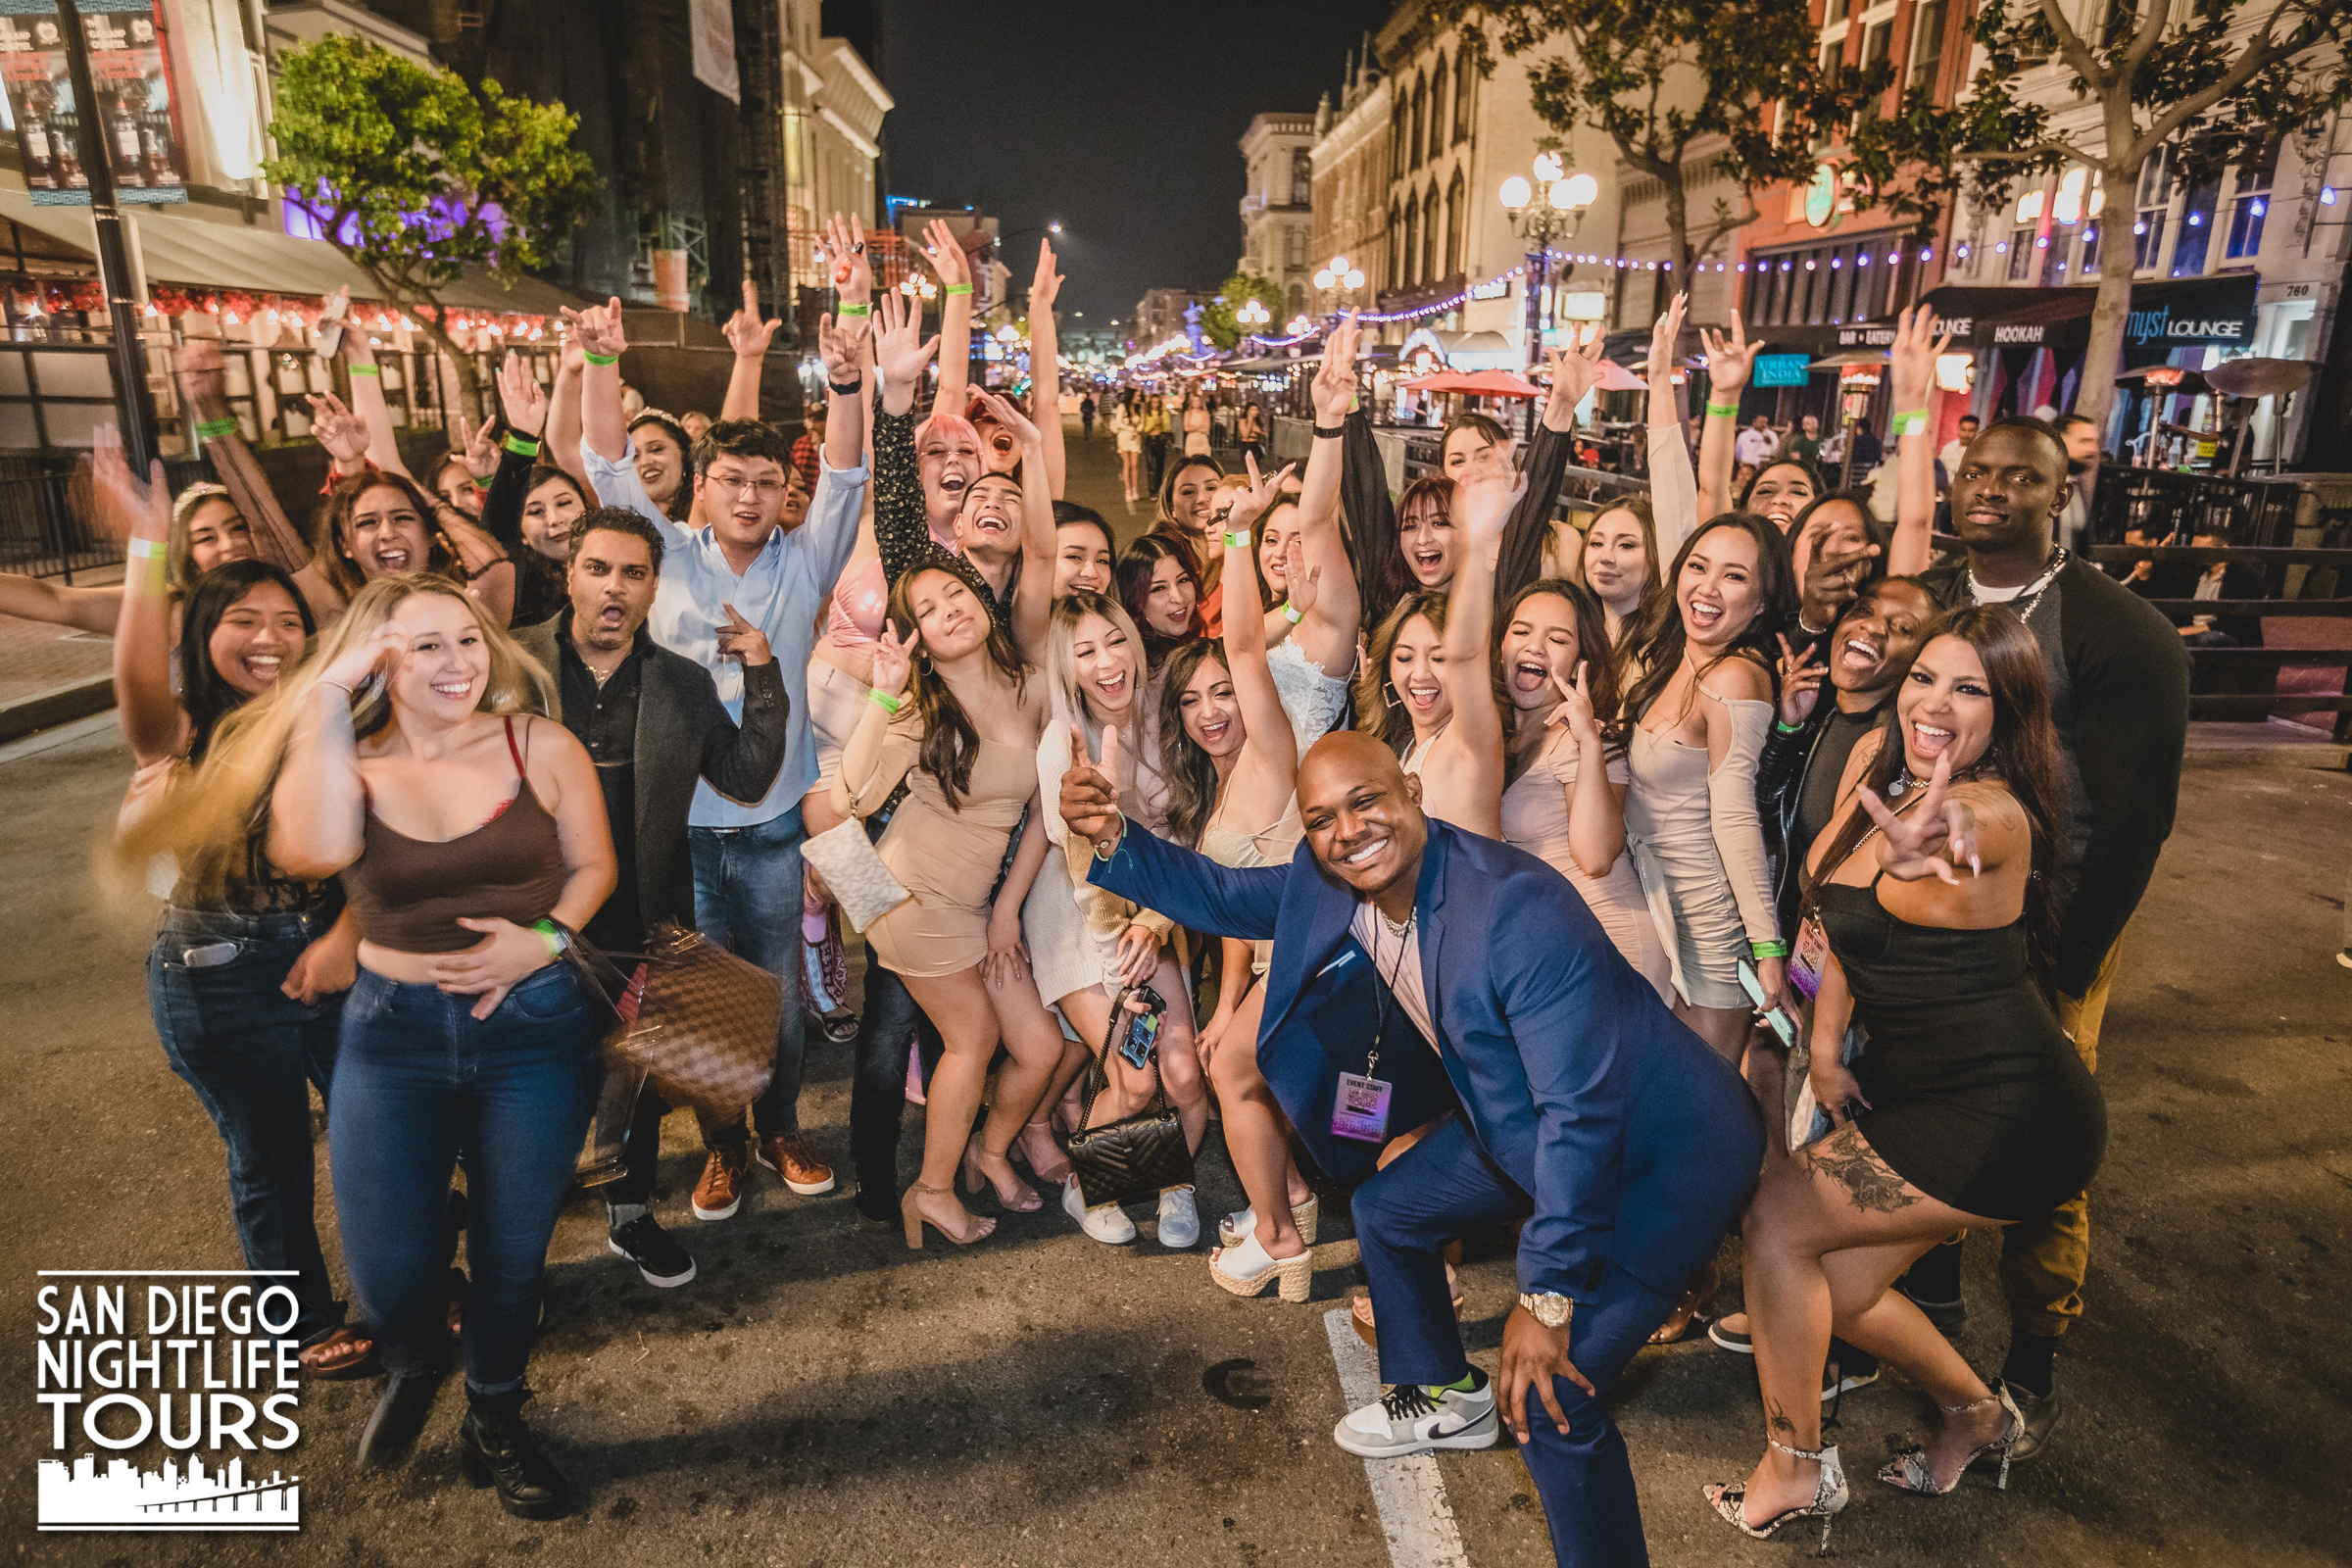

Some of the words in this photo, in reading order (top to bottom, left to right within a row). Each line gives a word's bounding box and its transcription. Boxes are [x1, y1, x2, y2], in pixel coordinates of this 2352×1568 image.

[2286, 285, 2309, 297] 760
[1934, 318, 1973, 335] OUNGE
[1994, 325, 2044, 343] HOOKAH
[2167, 319, 2243, 337] LOUNGE
[1839, 330, 1857, 345] BAR
[1347, 1079, 1365, 1089] EVENT
[1366, 1083, 1383, 1092] STAFF
